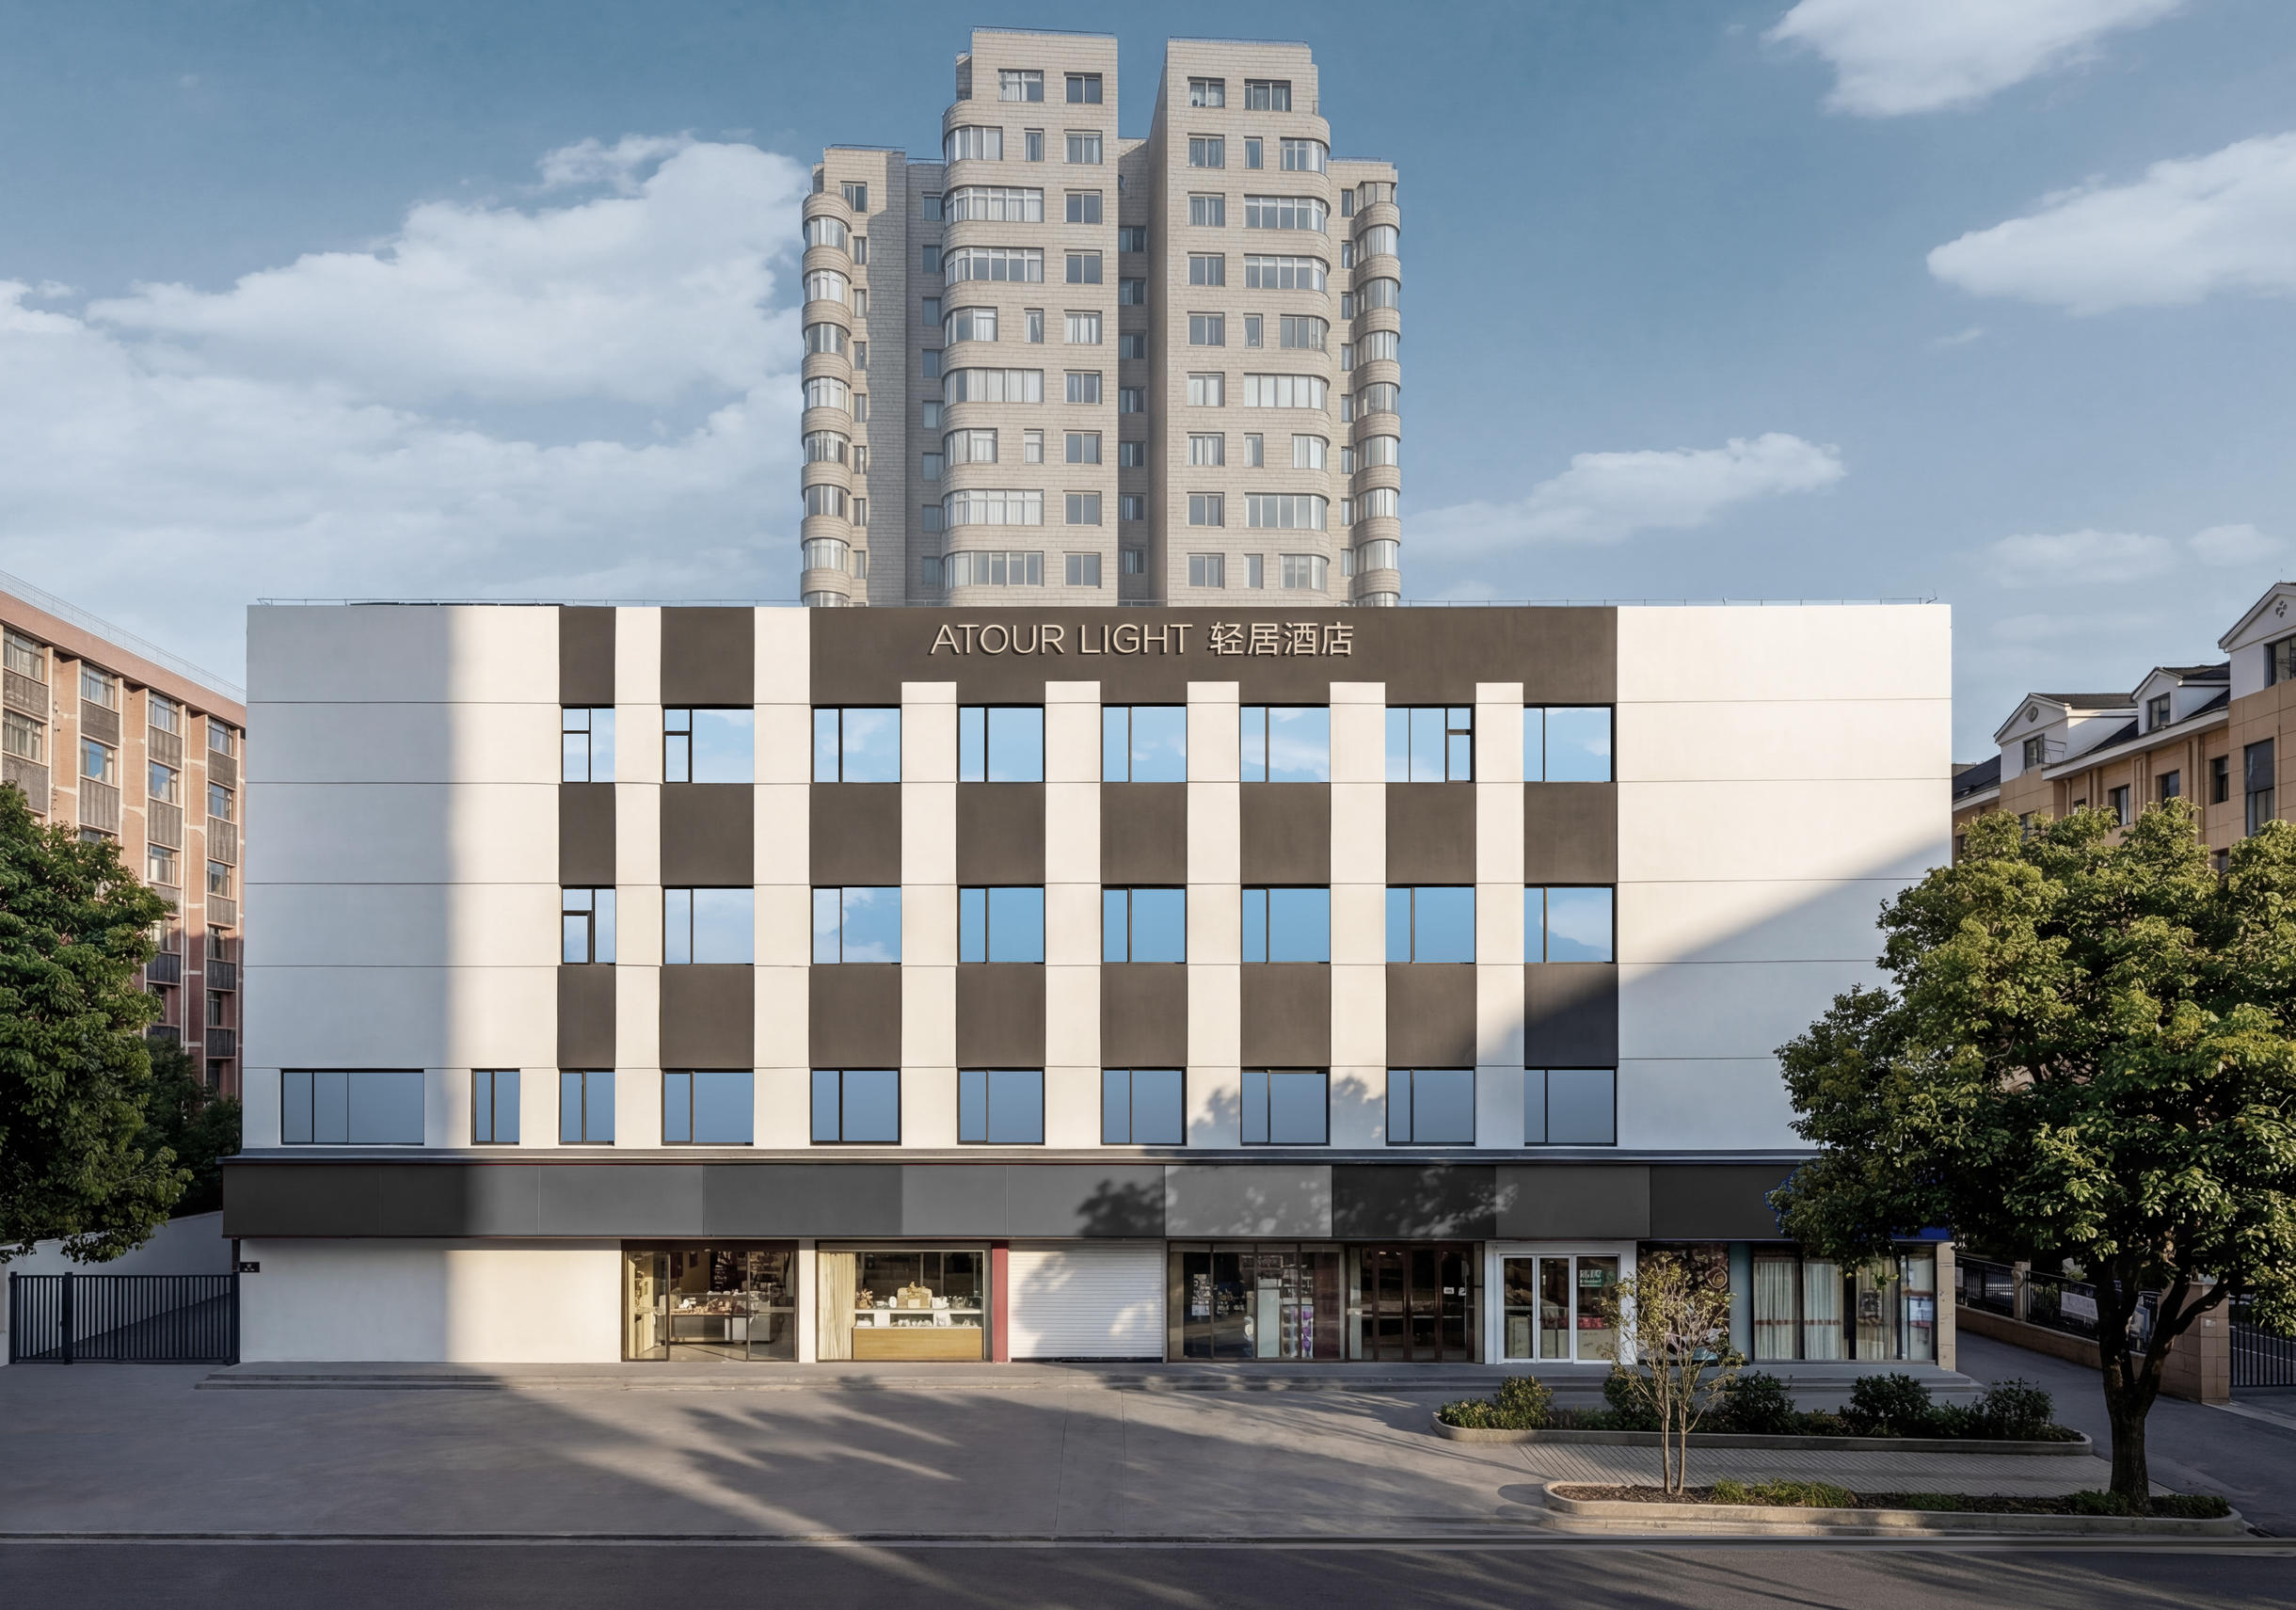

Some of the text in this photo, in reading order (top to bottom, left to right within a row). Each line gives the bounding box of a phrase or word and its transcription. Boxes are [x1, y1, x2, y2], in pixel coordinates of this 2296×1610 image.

[930, 623, 1193, 655] ATOUR LIGHT
[1209, 621, 1354, 656] 轻居酒店
